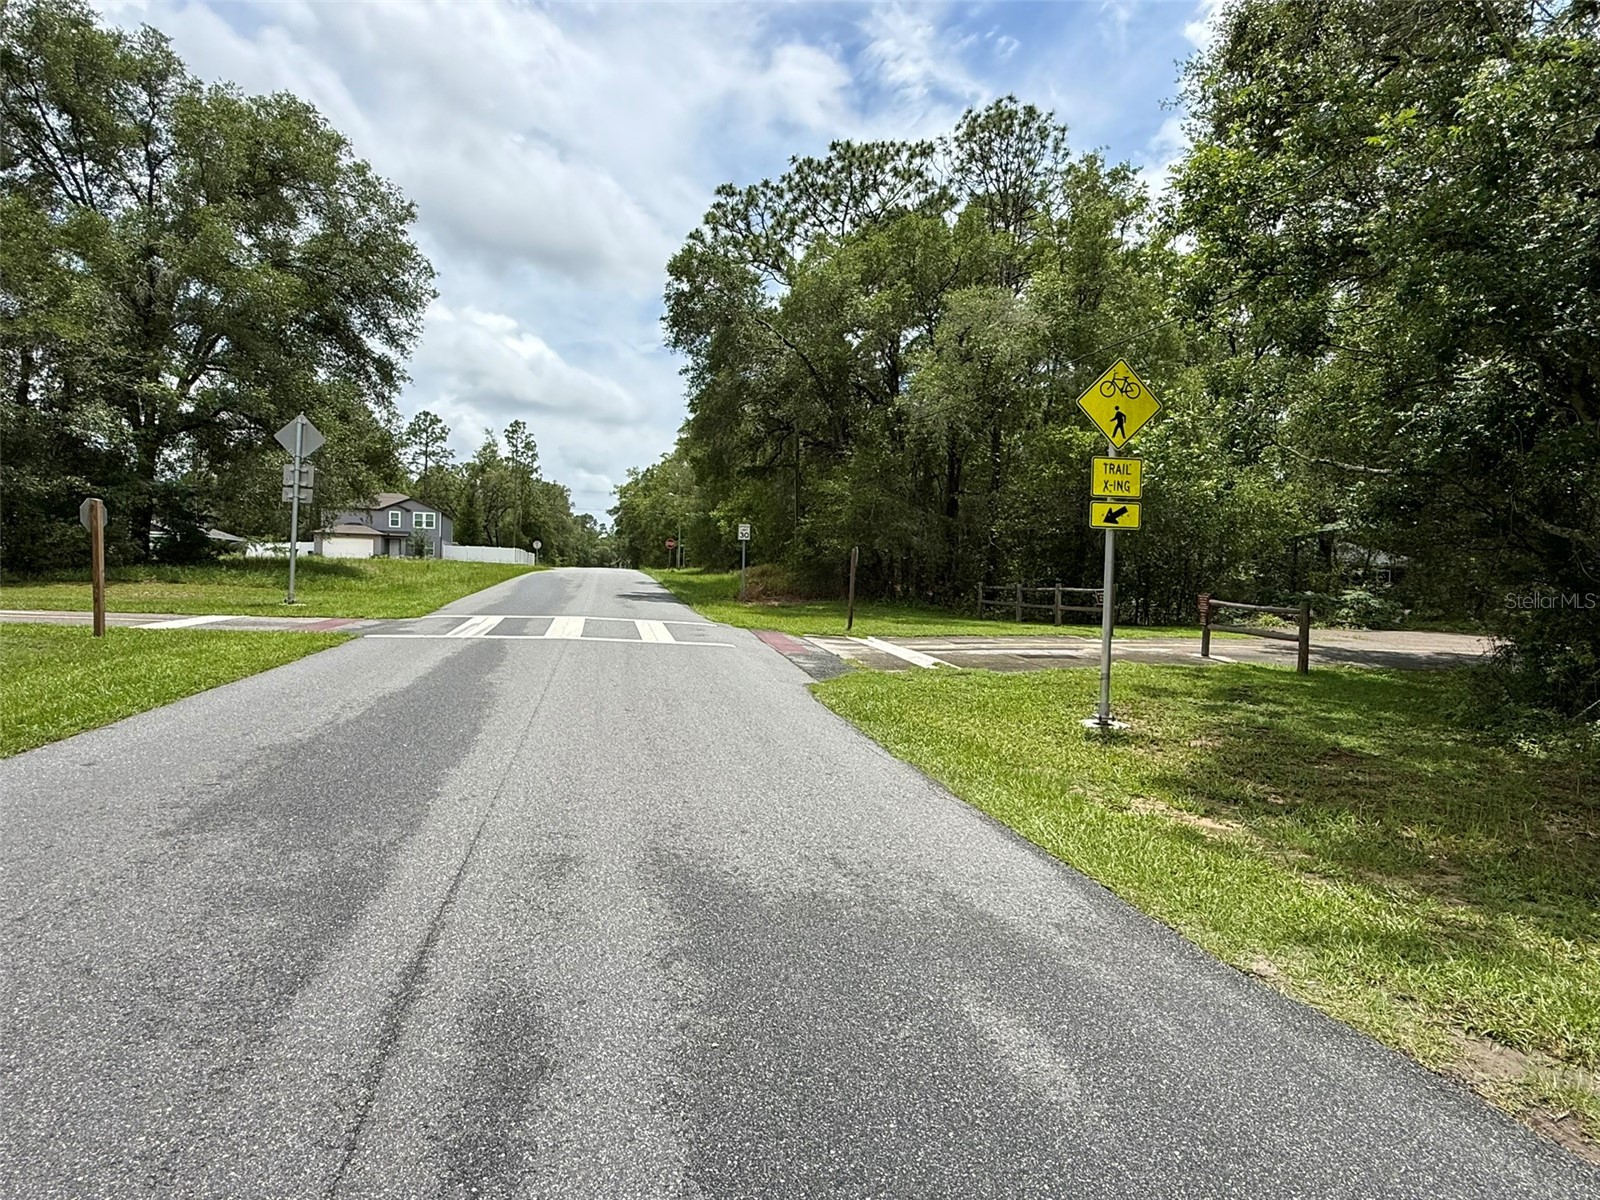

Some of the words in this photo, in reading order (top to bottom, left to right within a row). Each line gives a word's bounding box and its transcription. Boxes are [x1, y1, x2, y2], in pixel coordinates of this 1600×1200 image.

[1103, 462, 1132, 475] TRAIL
[1103, 480, 1131, 492] X-ING
[740, 531, 750, 539] 30
